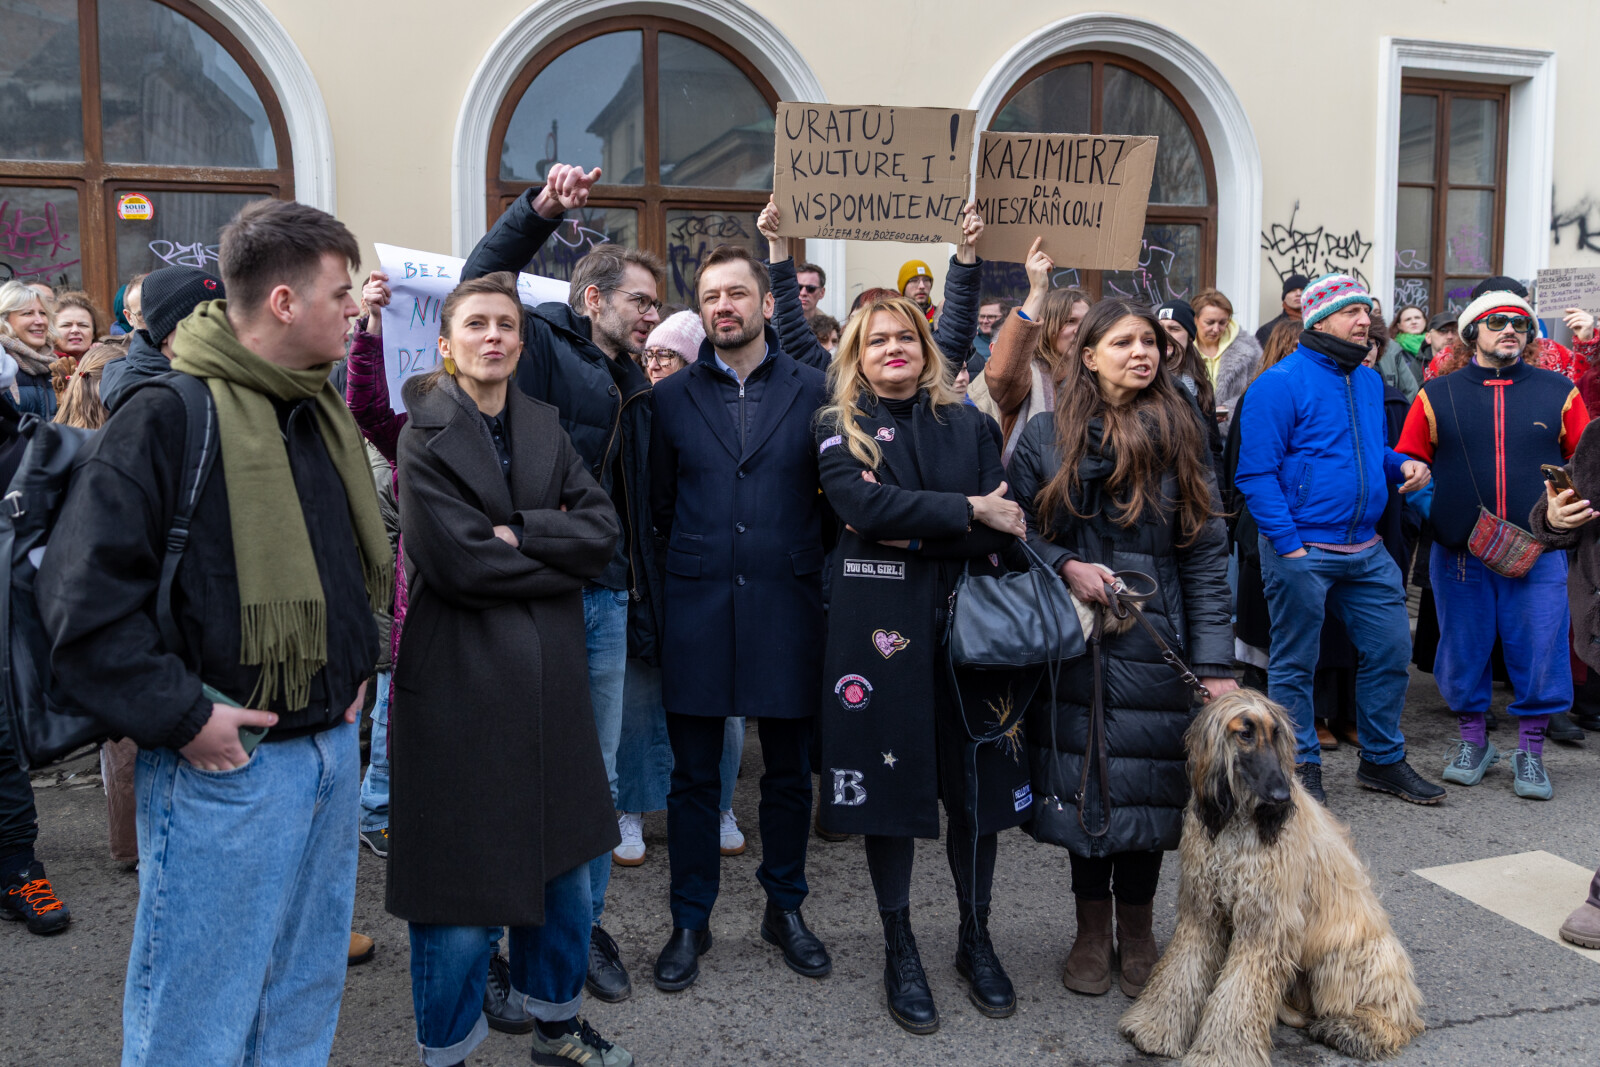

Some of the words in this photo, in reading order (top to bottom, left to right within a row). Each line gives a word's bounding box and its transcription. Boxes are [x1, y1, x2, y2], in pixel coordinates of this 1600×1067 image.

[790, 148, 908, 183] KULTURĘ
[921, 155, 936, 184] I
[981, 138, 1126, 185] KAZIMIERZ
[1033, 185, 1062, 198] DLA
[791, 192, 966, 227] WSPOMNIENIA
[814, 224, 852, 239] JÓZEFA
[401, 262, 452, 280] BEZ
[846, 563, 860, 572] YOU
[861, 564, 876, 575] GO,
[830, 767, 867, 806] B
